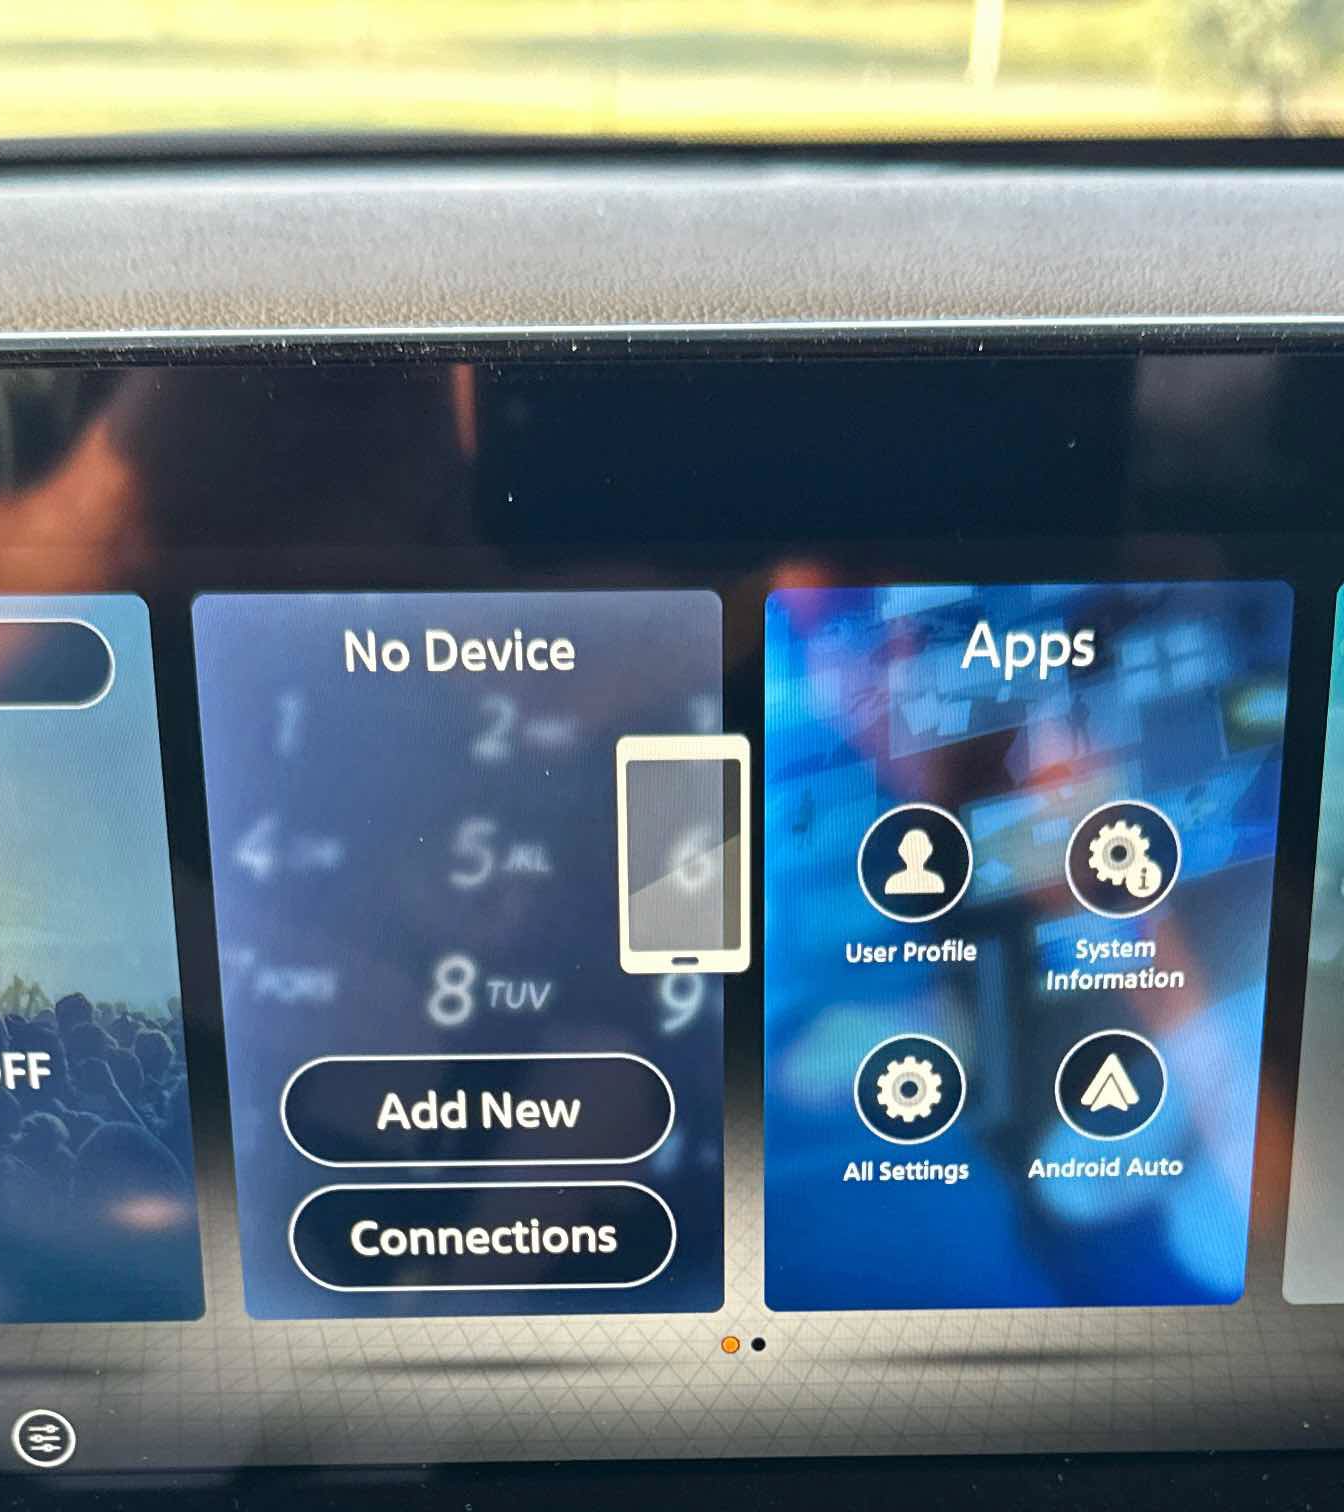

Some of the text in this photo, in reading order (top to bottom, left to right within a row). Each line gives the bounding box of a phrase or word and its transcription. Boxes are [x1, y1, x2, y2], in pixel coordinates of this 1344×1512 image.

[344, 627, 576, 673] No Device
[960, 618, 1097, 681] Apps
[471, 696, 517, 761] 2
[449, 817, 498, 890] 5
[670, 825, 714, 892] 6
[844, 938, 978, 964] User Profile
[1074, 938, 1156, 963] System
[427, 953, 552, 1027] 8 TUV
[1045, 967, 1186, 992] Information
[660, 974, 704, 1034] 9
[375, 1089, 582, 1131] Add New
[842, 1159, 969, 1187] All Settings
[1027, 1156, 1184, 1180] Android Auto
[350, 1217, 619, 1258] Connections
